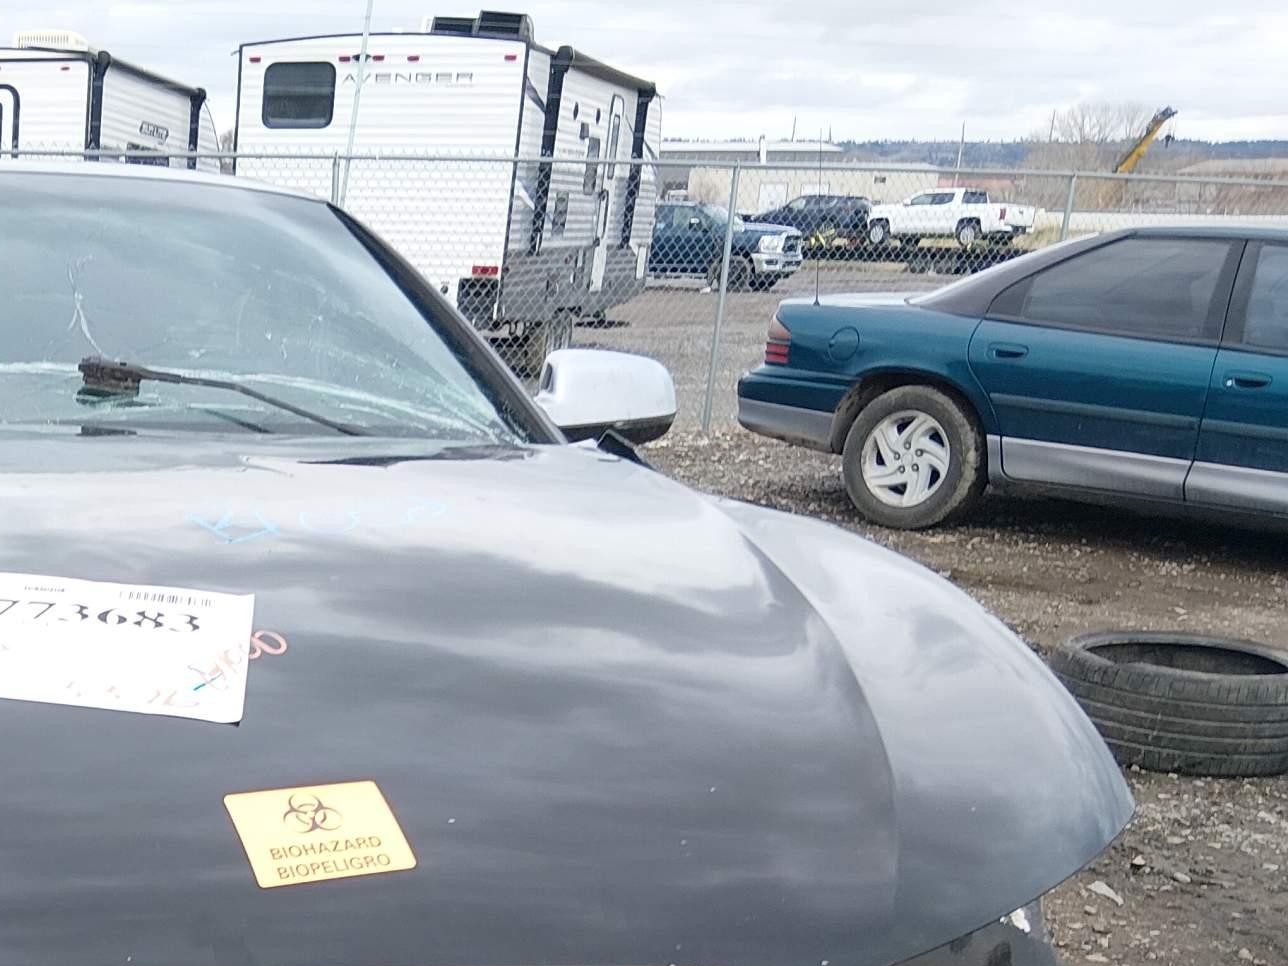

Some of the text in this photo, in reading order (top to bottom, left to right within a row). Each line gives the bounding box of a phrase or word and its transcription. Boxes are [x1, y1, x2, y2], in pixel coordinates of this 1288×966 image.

[342, 72, 473, 83] AVENGER
[269, 835, 382, 861] BIOHAZARD
[276, 853, 391, 880] BIOPELIGRO
